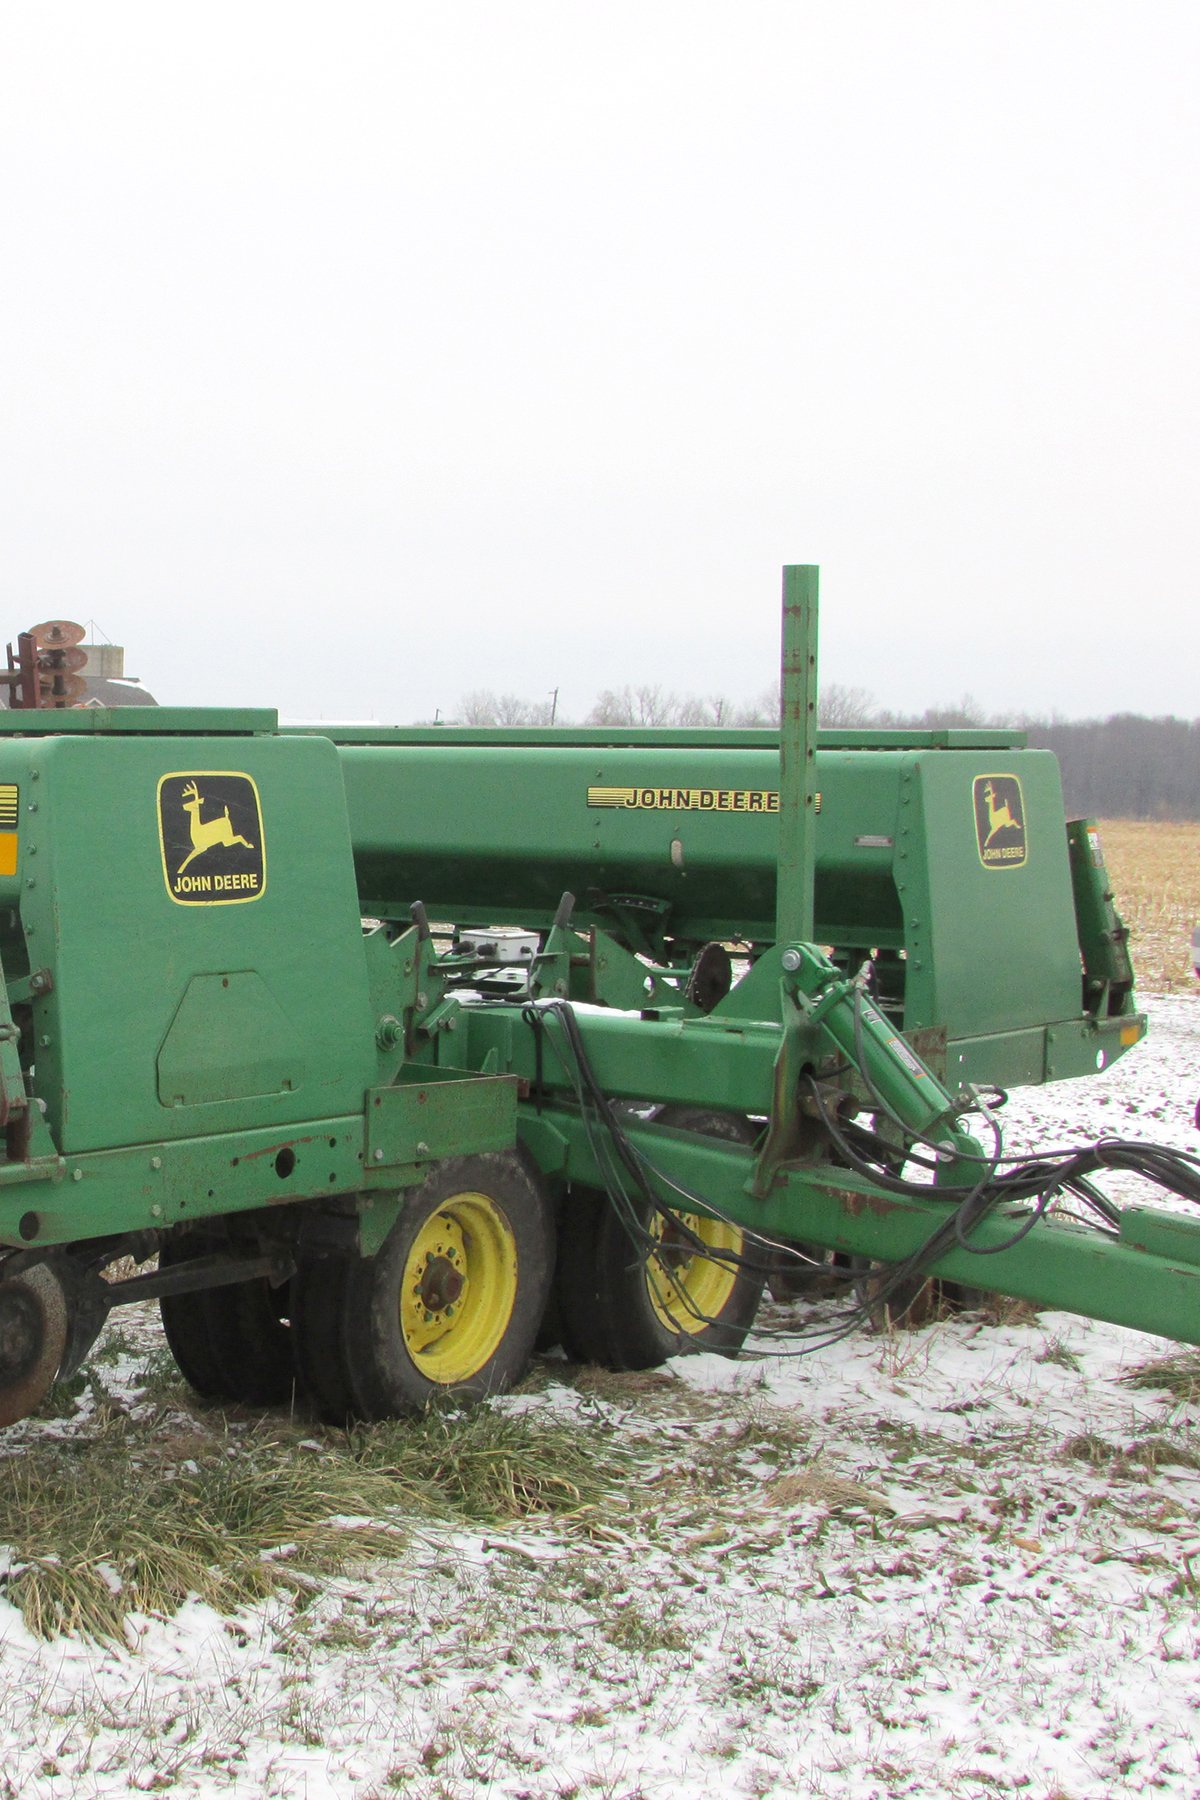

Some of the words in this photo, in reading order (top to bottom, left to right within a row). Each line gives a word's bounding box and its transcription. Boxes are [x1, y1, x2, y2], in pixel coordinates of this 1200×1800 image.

[624, 789, 692, 808] JOHN
[698, 790, 780, 812] DEERE
[173, 875, 212, 893] JOHN
[214, 873, 259, 891] DEERE
